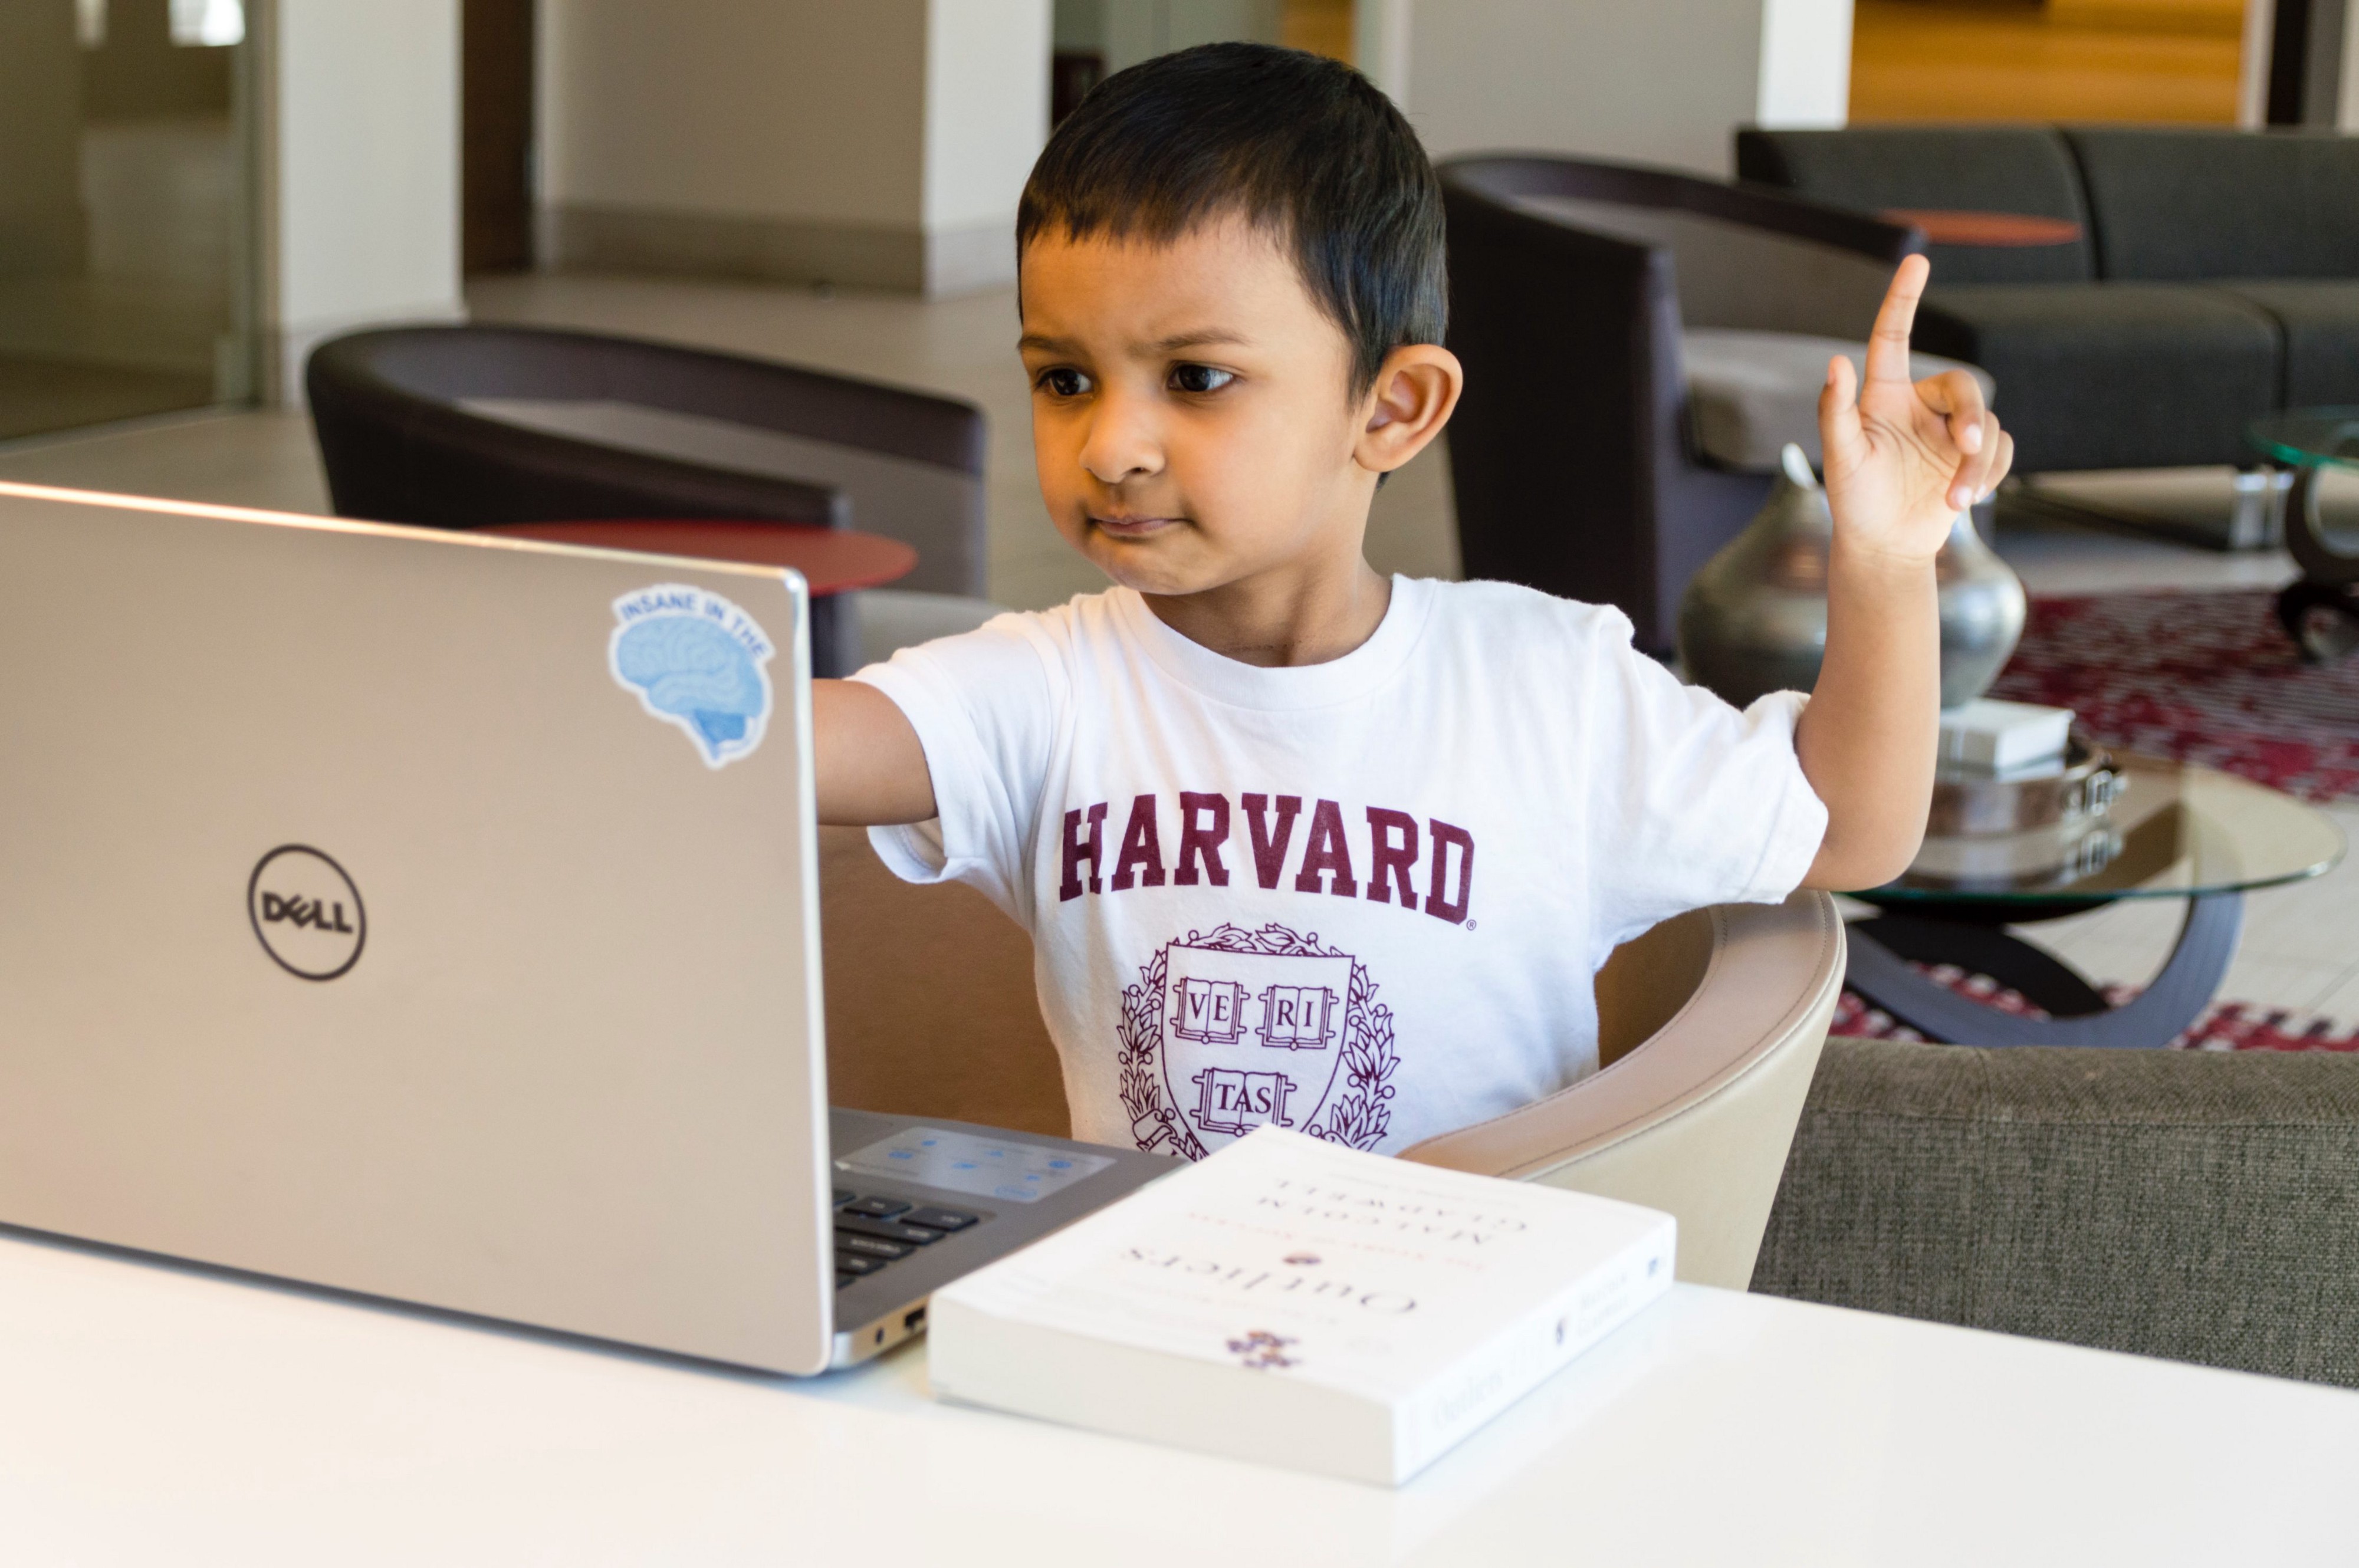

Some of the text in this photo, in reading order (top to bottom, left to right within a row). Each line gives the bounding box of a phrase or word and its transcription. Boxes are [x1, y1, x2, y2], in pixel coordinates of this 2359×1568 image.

[621, 591, 765, 656] INSANE IN THE
[1059, 791, 1476, 925] HARVARD
[262, 890, 353, 934] DELL
[1188, 992, 1315, 1027] VE RI
[1215, 1083, 1272, 1114] TAS
[1256, 1195, 1494, 1247] MALCOLM
[1119, 1247, 1418, 1315] Outliers
